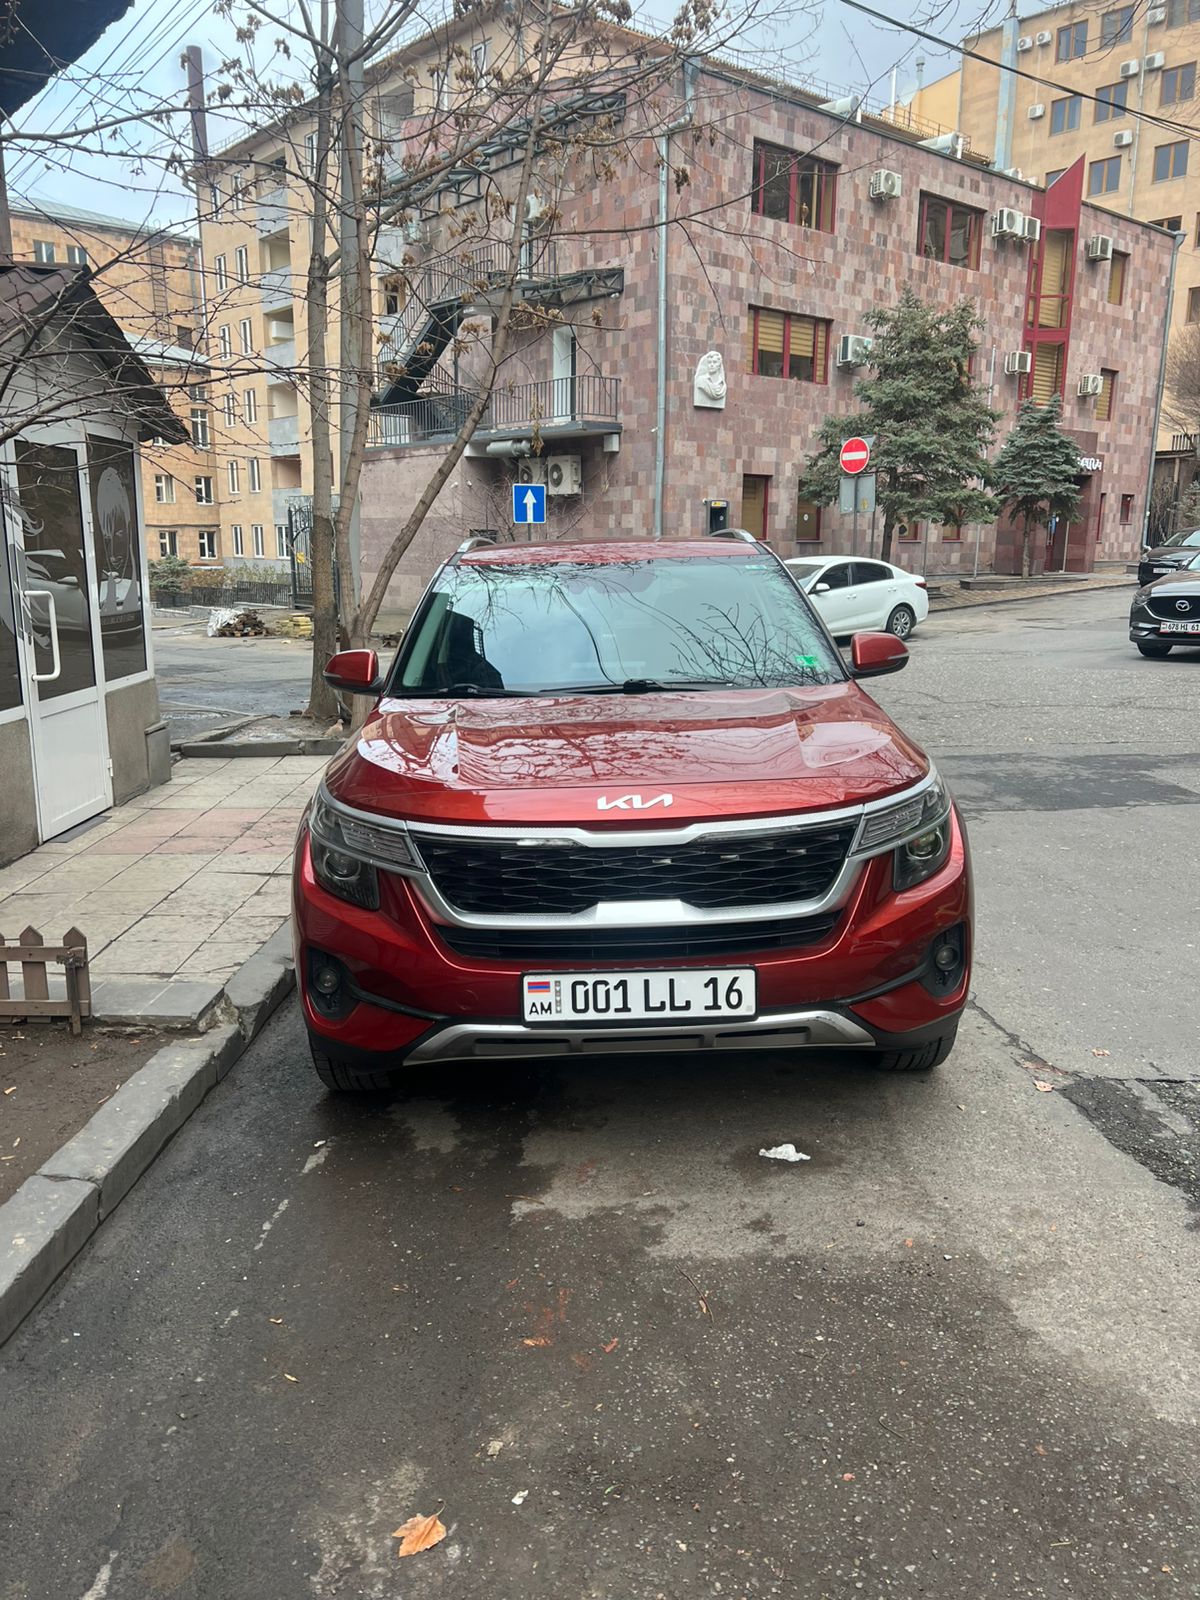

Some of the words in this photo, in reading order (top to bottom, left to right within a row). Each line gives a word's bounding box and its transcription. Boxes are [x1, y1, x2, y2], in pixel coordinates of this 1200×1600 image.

[597, 793, 673, 810] KIA
[571, 980, 631, 1013] 001
[644, 978, 691, 1012] LL
[704, 976, 743, 1010] 16
[529, 1001, 552, 1015] AM
